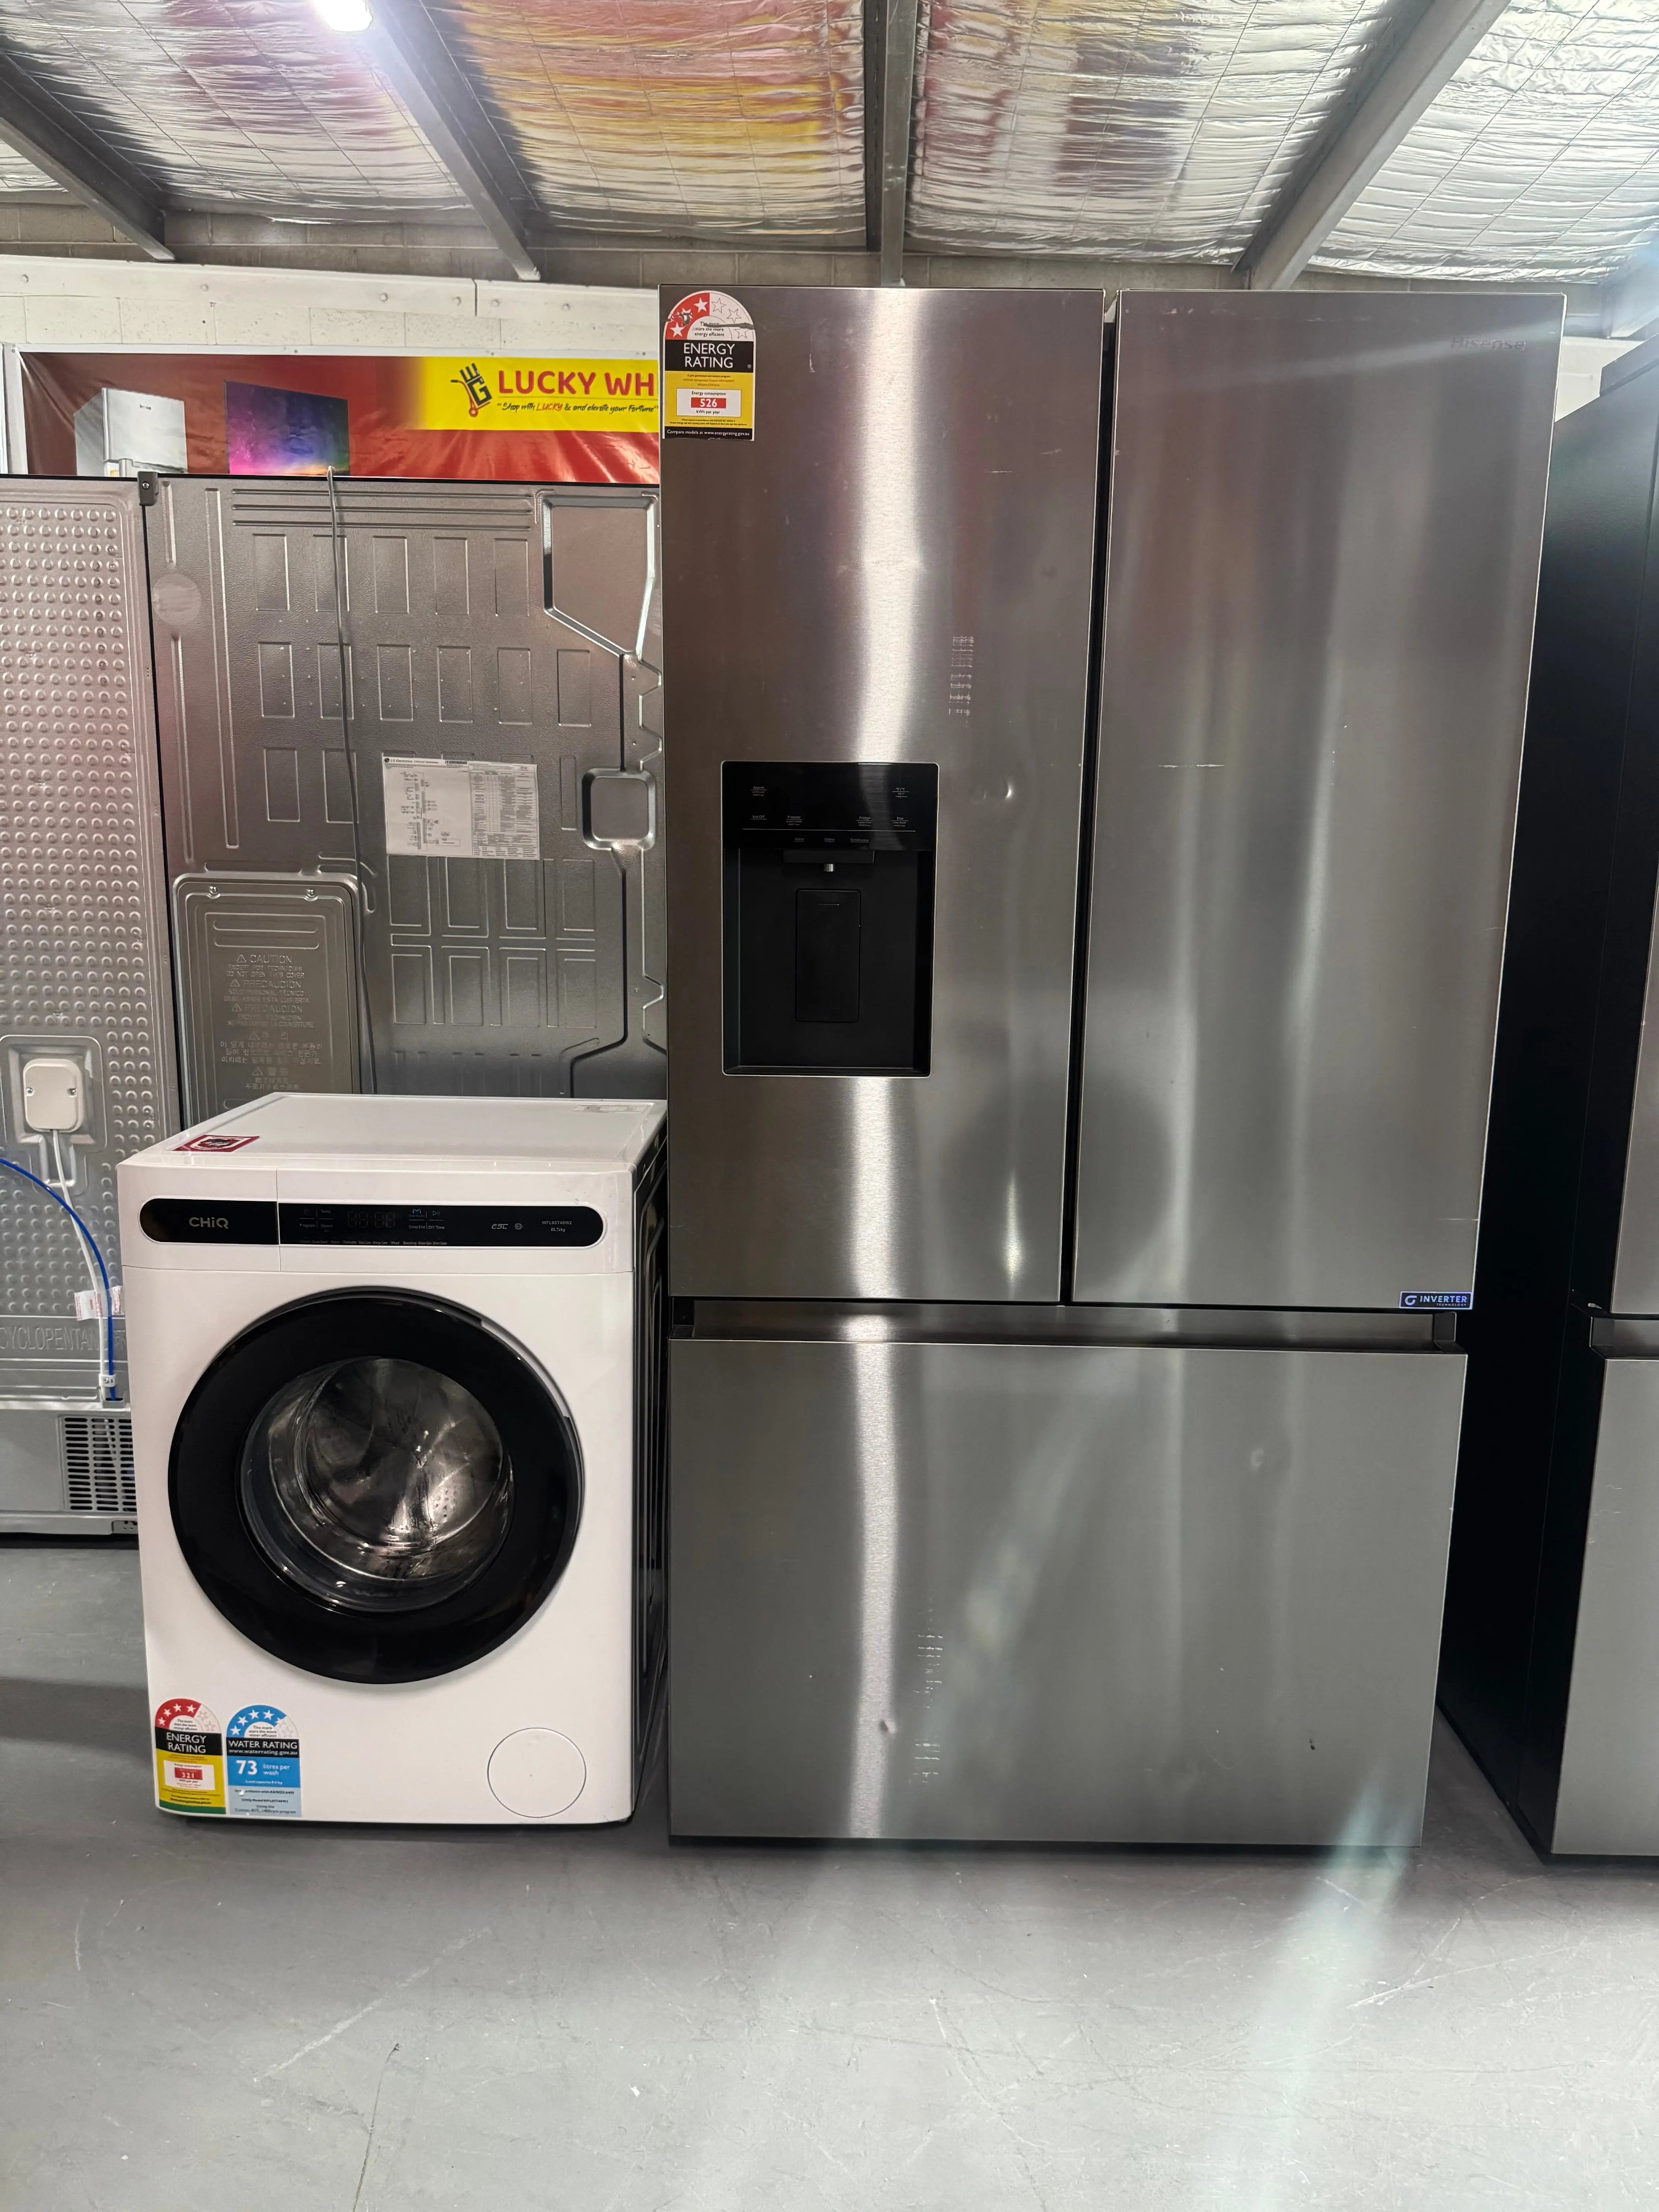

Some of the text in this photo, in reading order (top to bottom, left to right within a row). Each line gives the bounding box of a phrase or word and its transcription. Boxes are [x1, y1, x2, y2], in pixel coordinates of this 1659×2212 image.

[684, 343, 735, 355] ENERGY
[685, 357, 733, 368] RATING
[498, 370, 596, 395] LUCKY
[536, 403, 562, 412] LUCKY
[700, 398, 717, 407] 526
[251, 955, 292, 963] CAUTION
[189, 1217, 229, 1229] CHiQ
[166, 1732, 207, 1744] ENERGY
[168, 1743, 206, 1753] RATING
[228, 1740, 297, 1749] WATER RATING
[236, 1760, 258, 1775] 73
